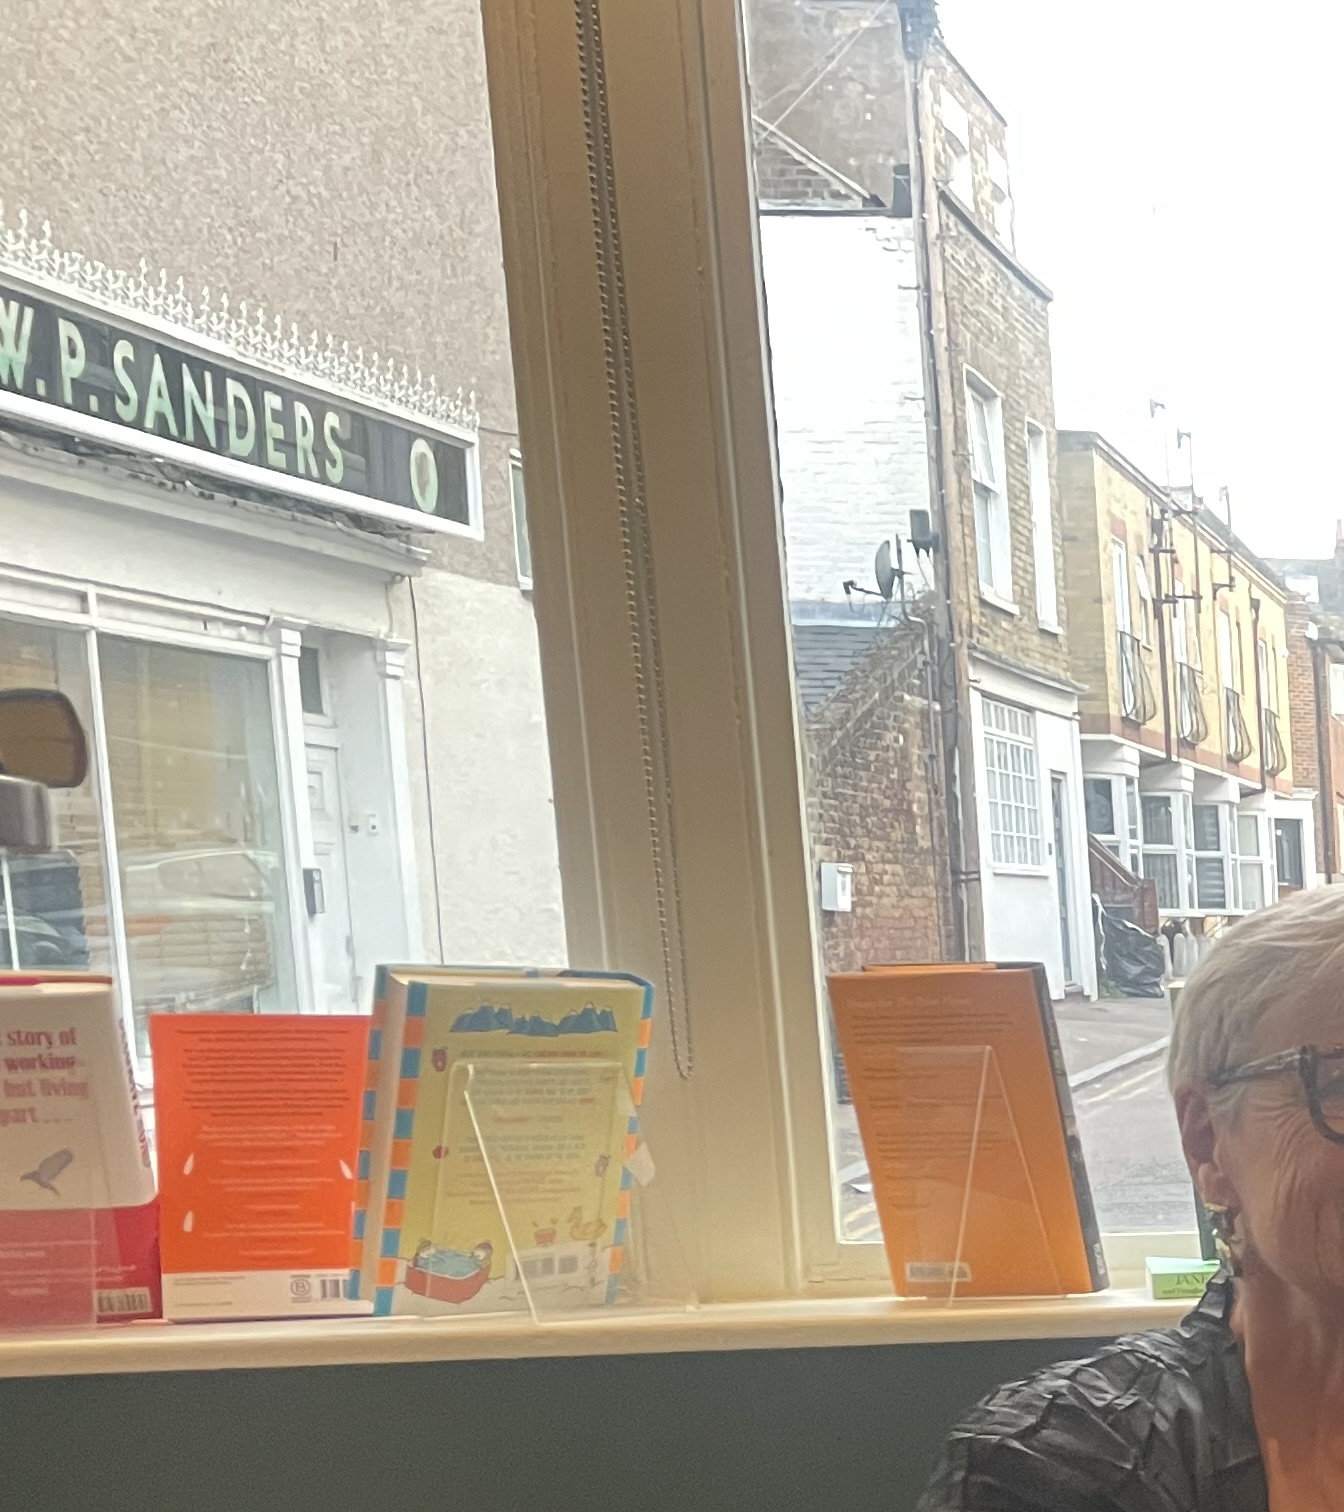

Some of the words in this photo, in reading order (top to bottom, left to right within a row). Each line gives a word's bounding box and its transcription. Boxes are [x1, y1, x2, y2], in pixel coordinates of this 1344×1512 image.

[113, 339, 345, 484] SANDERS
[7, 1030, 53, 1050] story
[59, 1026, 77, 1046] of
